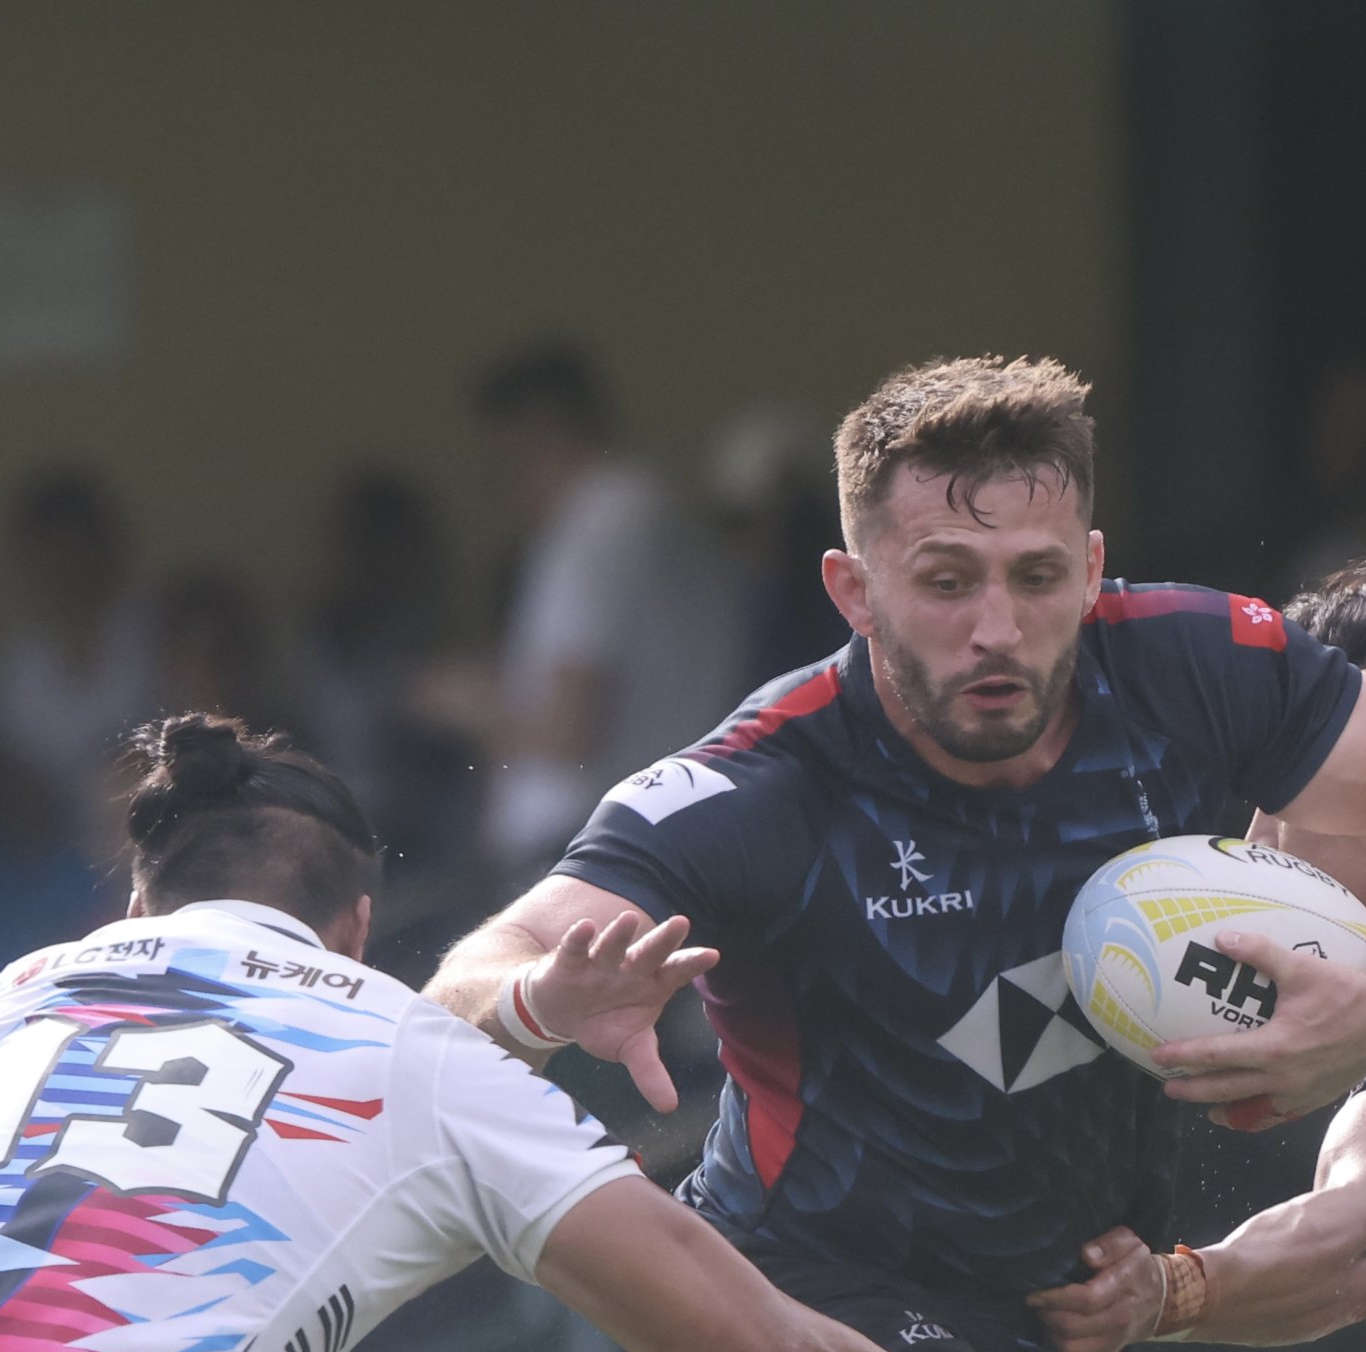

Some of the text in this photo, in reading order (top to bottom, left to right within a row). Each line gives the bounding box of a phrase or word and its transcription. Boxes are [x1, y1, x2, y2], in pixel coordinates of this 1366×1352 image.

[865, 889, 975, 921] KUKRI
[240, 949, 366, 999] 뉴케어
[1211, 1001, 1266, 1028] VORT
